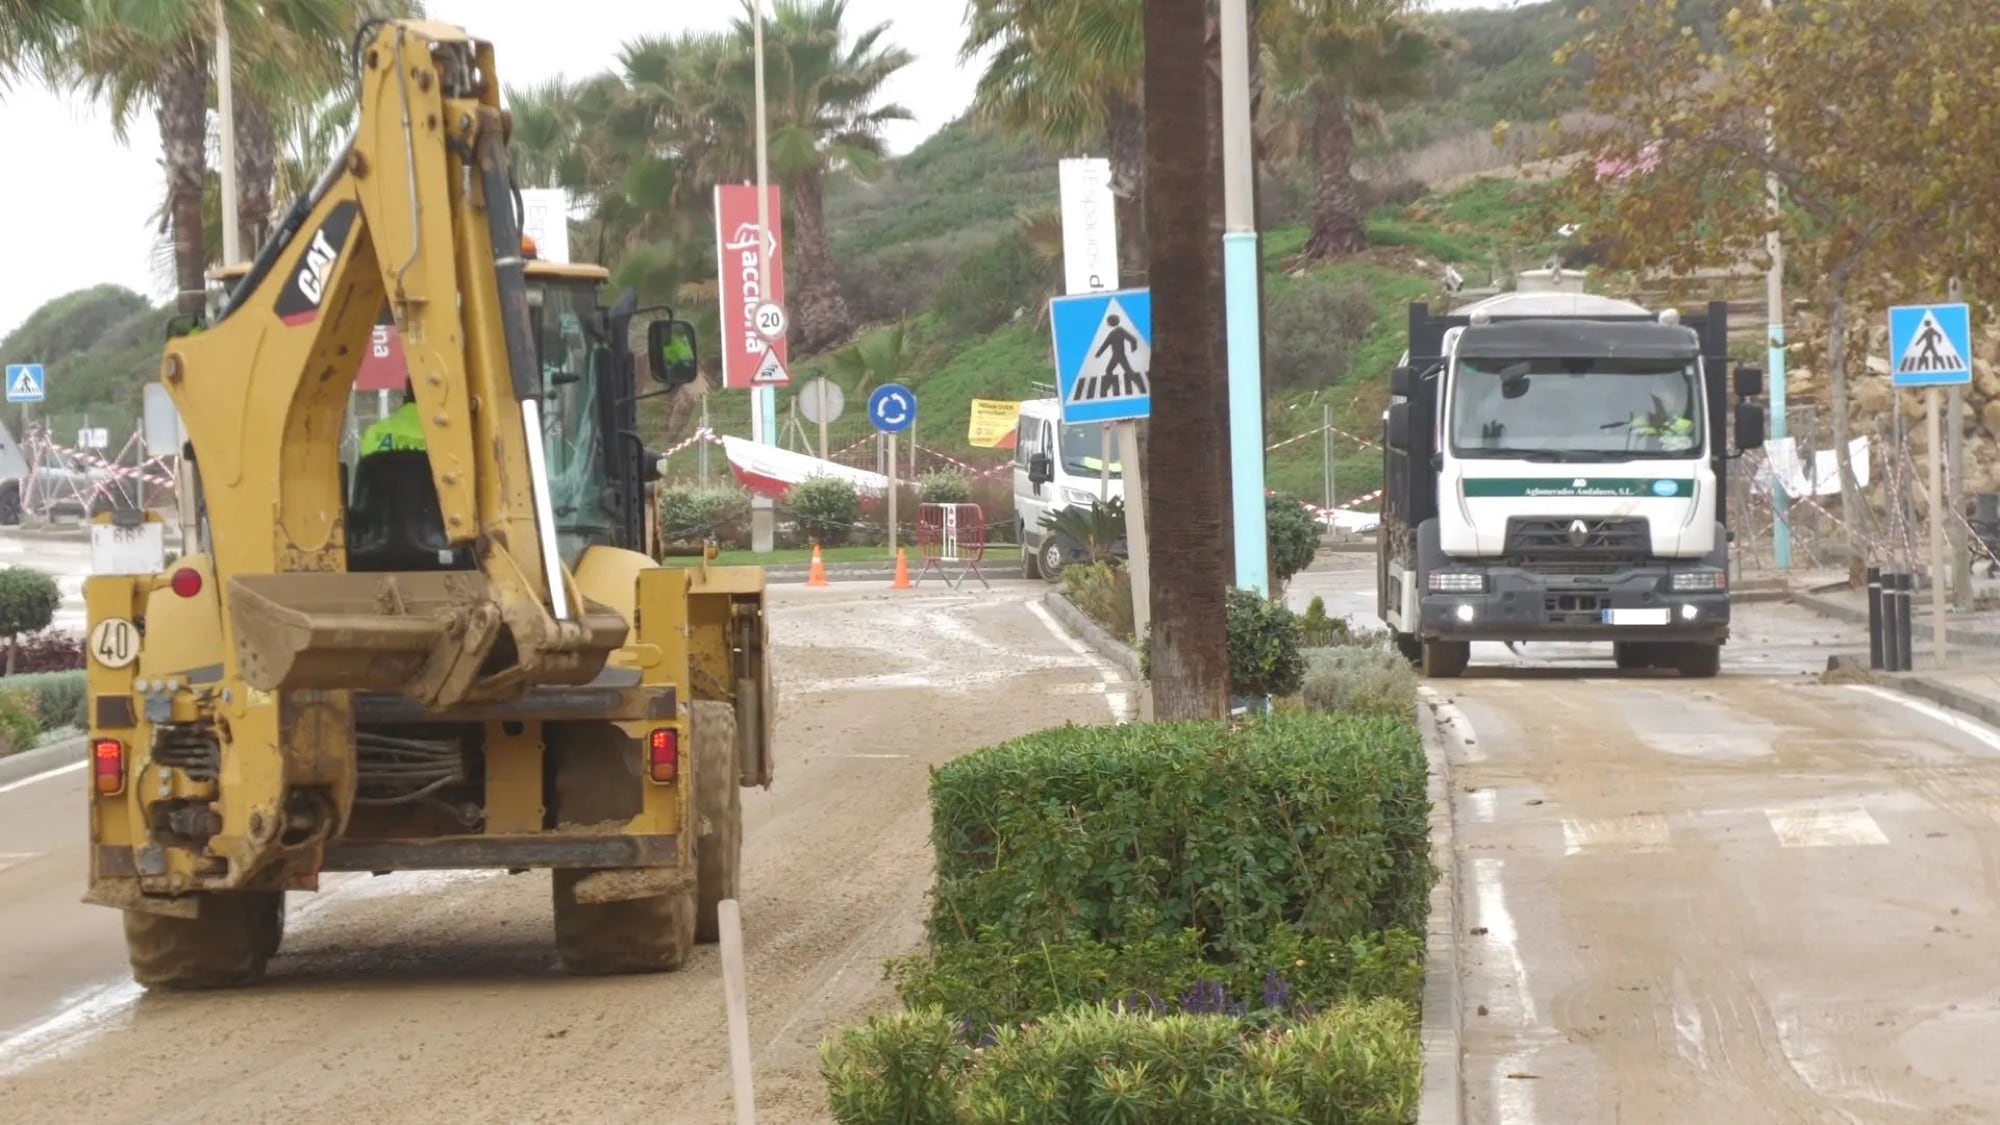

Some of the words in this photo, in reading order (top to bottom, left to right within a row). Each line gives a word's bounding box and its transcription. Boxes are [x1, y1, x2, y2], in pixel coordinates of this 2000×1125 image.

[298, 228, 338, 305] CAT
[760, 311, 780, 328] 20
[99, 622, 128, 660] 40
